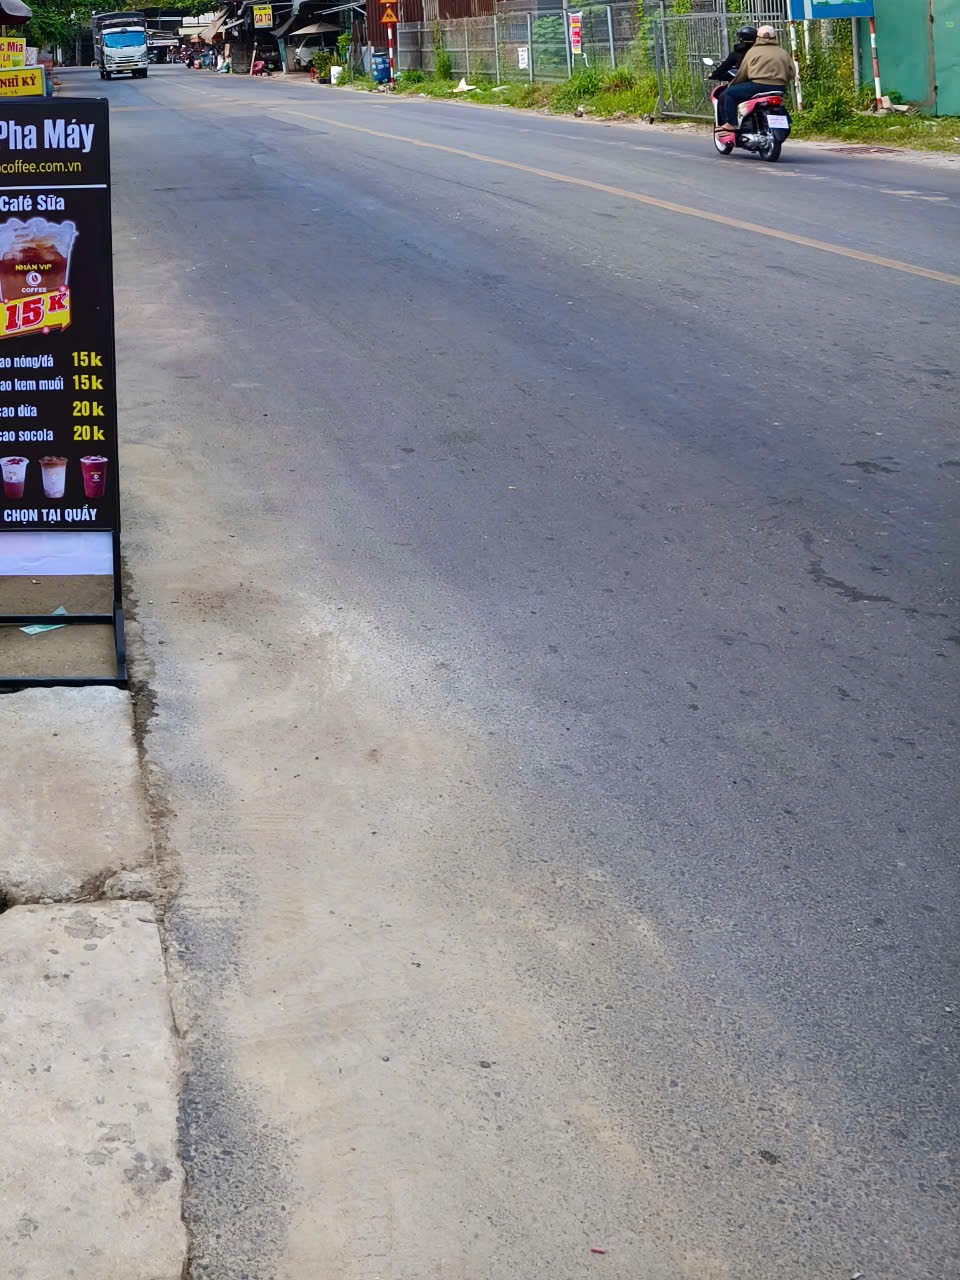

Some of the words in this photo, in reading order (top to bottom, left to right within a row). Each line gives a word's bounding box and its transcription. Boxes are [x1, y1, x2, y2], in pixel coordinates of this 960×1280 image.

[44, 118, 95, 153] Máy
[0, 195, 32, 211] Café
[37, 194, 65, 210] Sữa
[14, 378, 36, 391] kem
[39, 375, 64, 390] muối
[19, 428, 54, 441] socola
[3, 509, 38, 525] CHỌN
[41, 509, 60, 524] TẠI
